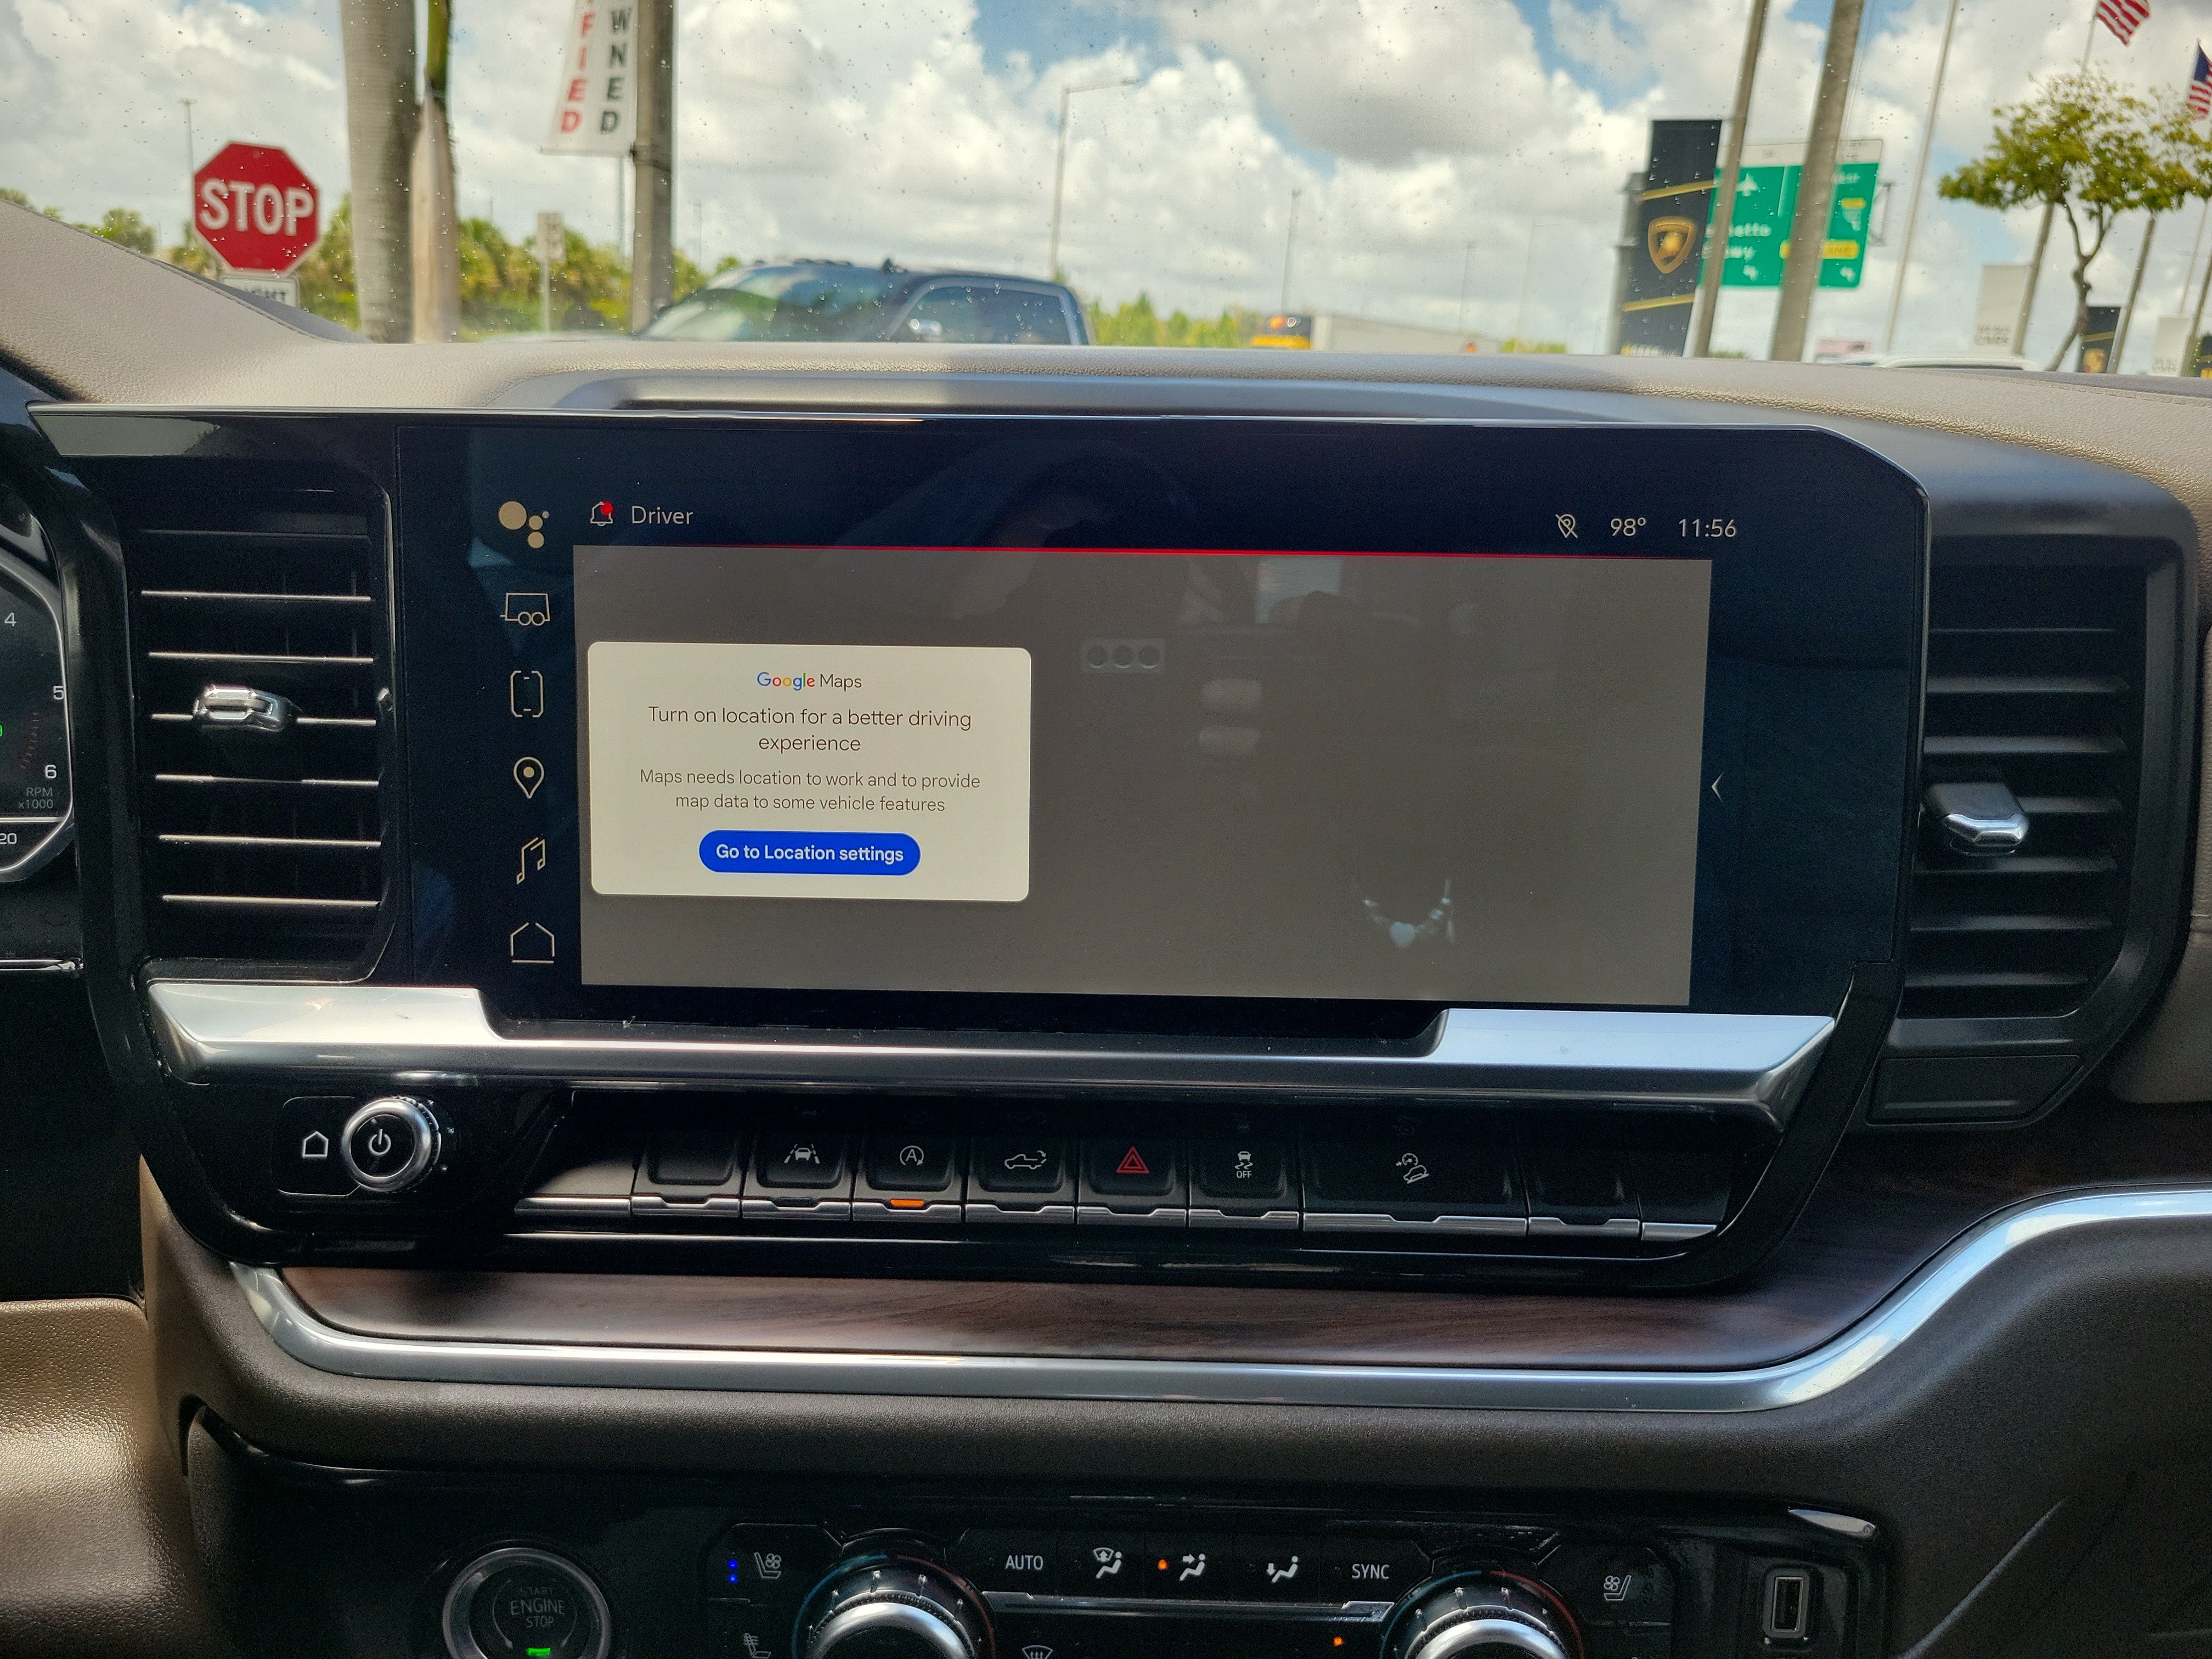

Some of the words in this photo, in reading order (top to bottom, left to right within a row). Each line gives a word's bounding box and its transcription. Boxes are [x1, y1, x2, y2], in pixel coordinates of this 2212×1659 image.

[560, 0, 596, 134] FIED
[199, 178, 315, 237] STOP
[631, 505, 693, 524] Driver
[1679, 518, 1737, 538] 11:56
[4, 612, 17, 627] 4
[757, 672, 815, 691] Google
[820, 673, 862, 691] Maps
[53, 686, 64, 700] 5
[648, 707, 689, 723] Turn
[694, 710, 716, 723] on
[723, 707, 795, 724] location
[800, 709, 827, 725] for
[832, 713, 843, 725] a
[848, 709, 904, 726] better
[909, 710, 972, 731] driving
[758, 735, 861, 754] experience
[44, 764, 57, 779] 6
[640, 769, 682, 787] Maps
[687, 770, 735, 785] needs
[740, 770, 801, 786] location
[806, 772, 821, 786] to
[826, 771, 864, 786] work
[868, 772, 896, 787] and
[901, 774, 917, 788] to
[922, 773, 981, 792] provide
[26, 787, 53, 797] RPM
[18, 799, 53, 809] x1000
[675, 797, 709, 811] map
[714, 793, 748, 809] data
[753, 795, 769, 809] to
[772, 798, 815, 810] some
[819, 795, 875, 810] vehicle
[879, 795, 946, 812] features
[716, 844, 740, 859] Go
[743, 845, 760, 859] to
[764, 845, 835, 860] Location
[839, 846, 904, 865] settings
[1236, 1170, 1252, 1179] OFF
[1005, 1554, 1044, 1571] AUTO
[1351, 1564, 1390, 1579] SYNC
[510, 1597, 566, 1616] ENGINE
[526, 1615, 555, 1628] STOP
